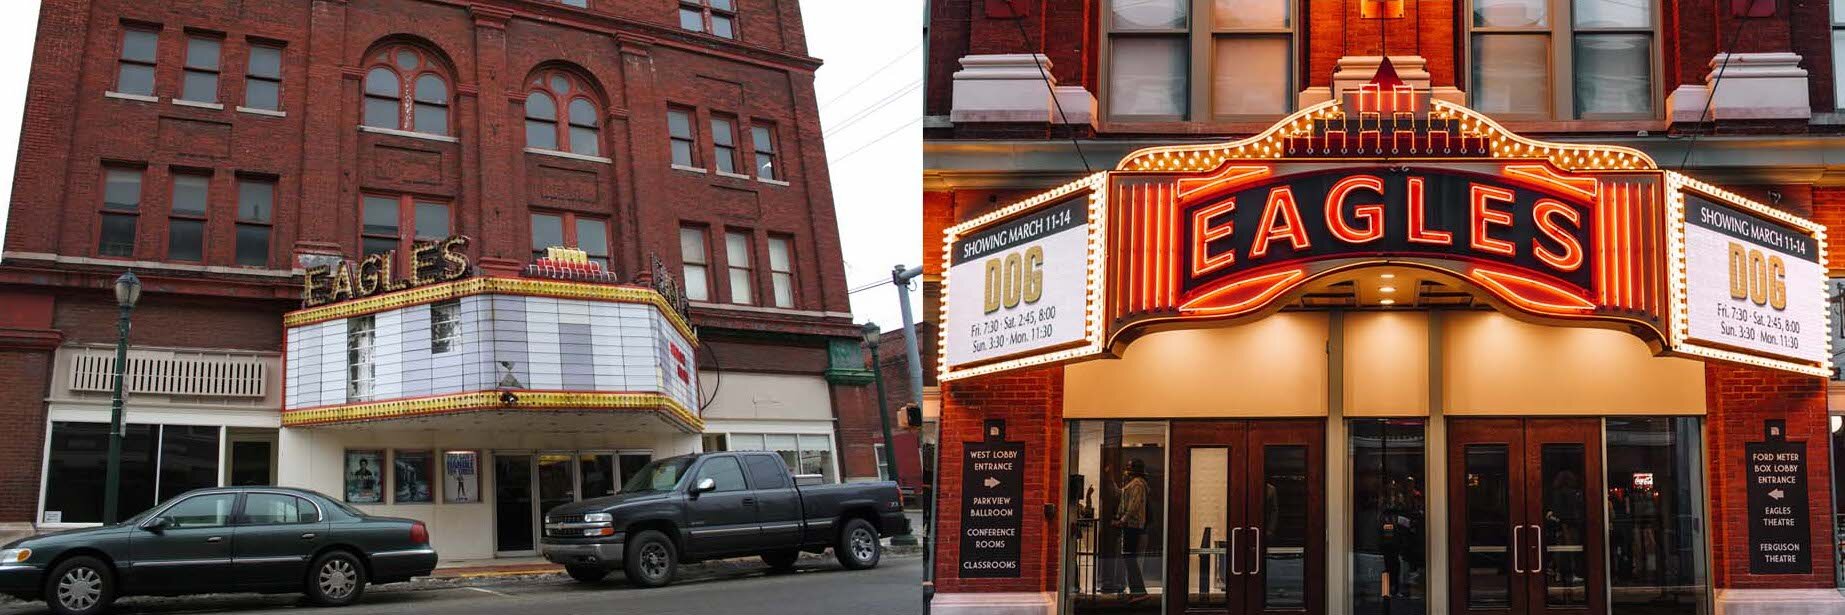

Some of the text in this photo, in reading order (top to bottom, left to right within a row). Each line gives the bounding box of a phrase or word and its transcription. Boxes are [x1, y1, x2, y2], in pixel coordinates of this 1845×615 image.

[1192, 175, 1583, 278] EAGLES
[1701, 207, 1806, 255] SHOWING MARCH 11-14
[963, 209, 1071, 258] SHOWING MARCH 11-14
[304, 234, 470, 307] EAGLES
[984, 245, 1043, 315] DOG
[1728, 241, 1787, 311] DOG
[971, 306, 1056, 337] Fri. 7:30 Sat. 2:45, 8:00
[1717, 303, 1800, 334] Fri. 7:30 Sat. 2:45, 8:00
[972, 324, 1052, 353] Sun. 3:30 Mon. 11:30
[1721, 321, 1799, 349] Sun. 3:30 Mon. 11:30
[970, 450, 1018, 459] WEST LOBBY
[1752, 453, 1799, 461] FORD METER
[974, 462, 1013, 471] ENTRANCE
[1754, 464, 1798, 473] BOX LOBBY
[1758, 476, 1796, 484] ENTRANCE
[973, 497, 1011, 505] PARKVIEW
[970, 509, 1013, 517] BALLROOM
[1765, 507, 1791, 515] EAGLES
[1763, 518, 1795, 526] THEATRE
[967, 528, 1015, 537] CONFERENCE
[975, 540, 1006, 548] ROOMS
[1760, 543, 1800, 551] FERGUSON
[1765, 555, 1797, 563] THEATRE
[963, 561, 1017, 570] CLASSROOMS
